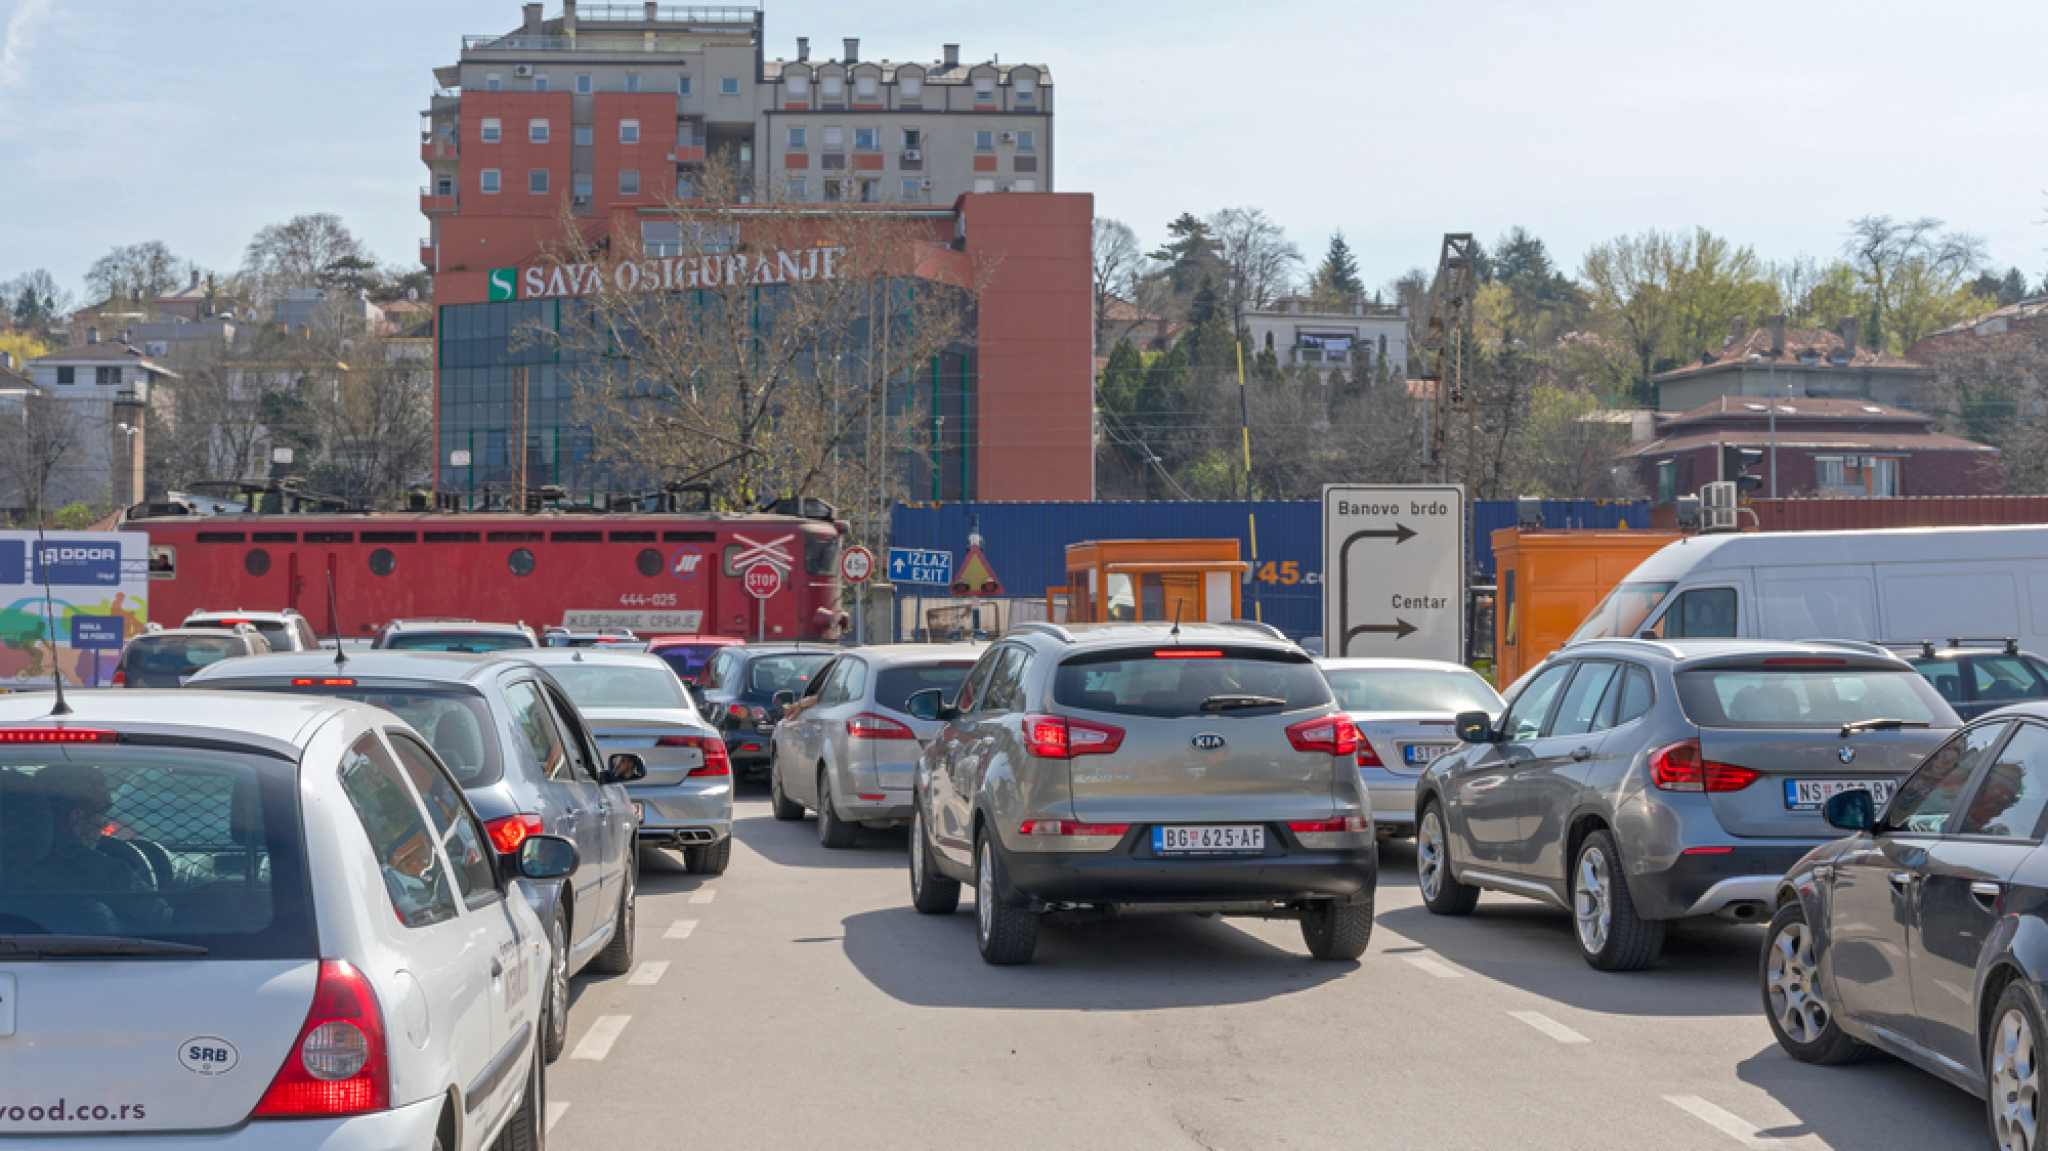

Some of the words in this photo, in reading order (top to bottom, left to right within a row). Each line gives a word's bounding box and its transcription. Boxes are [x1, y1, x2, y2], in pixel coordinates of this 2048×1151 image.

[525, 263, 605, 298] SAVA
[615, 246, 847, 292] OSIGURANJE
[1338, 500, 1400, 516] Banovo
[1410, 500, 1449, 516] brdo
[907, 552, 949, 568] IZLAZ
[748, 572, 777, 587] STOP
[912, 566, 945, 583] EXIT
[619, 593, 677, 607] 444-025
[1391, 593, 1448, 609] Centar
[568, 613, 643, 629] ЖЕЛЕЗНИЦЕ
[649, 613, 697, 629] СРБИЈЕ
[1192, 735, 1222, 748] KIA
[1799, 783, 1822, 801] NS
[1166, 828, 1189, 848] BG
[188, 1046, 228, 1063] SRB
